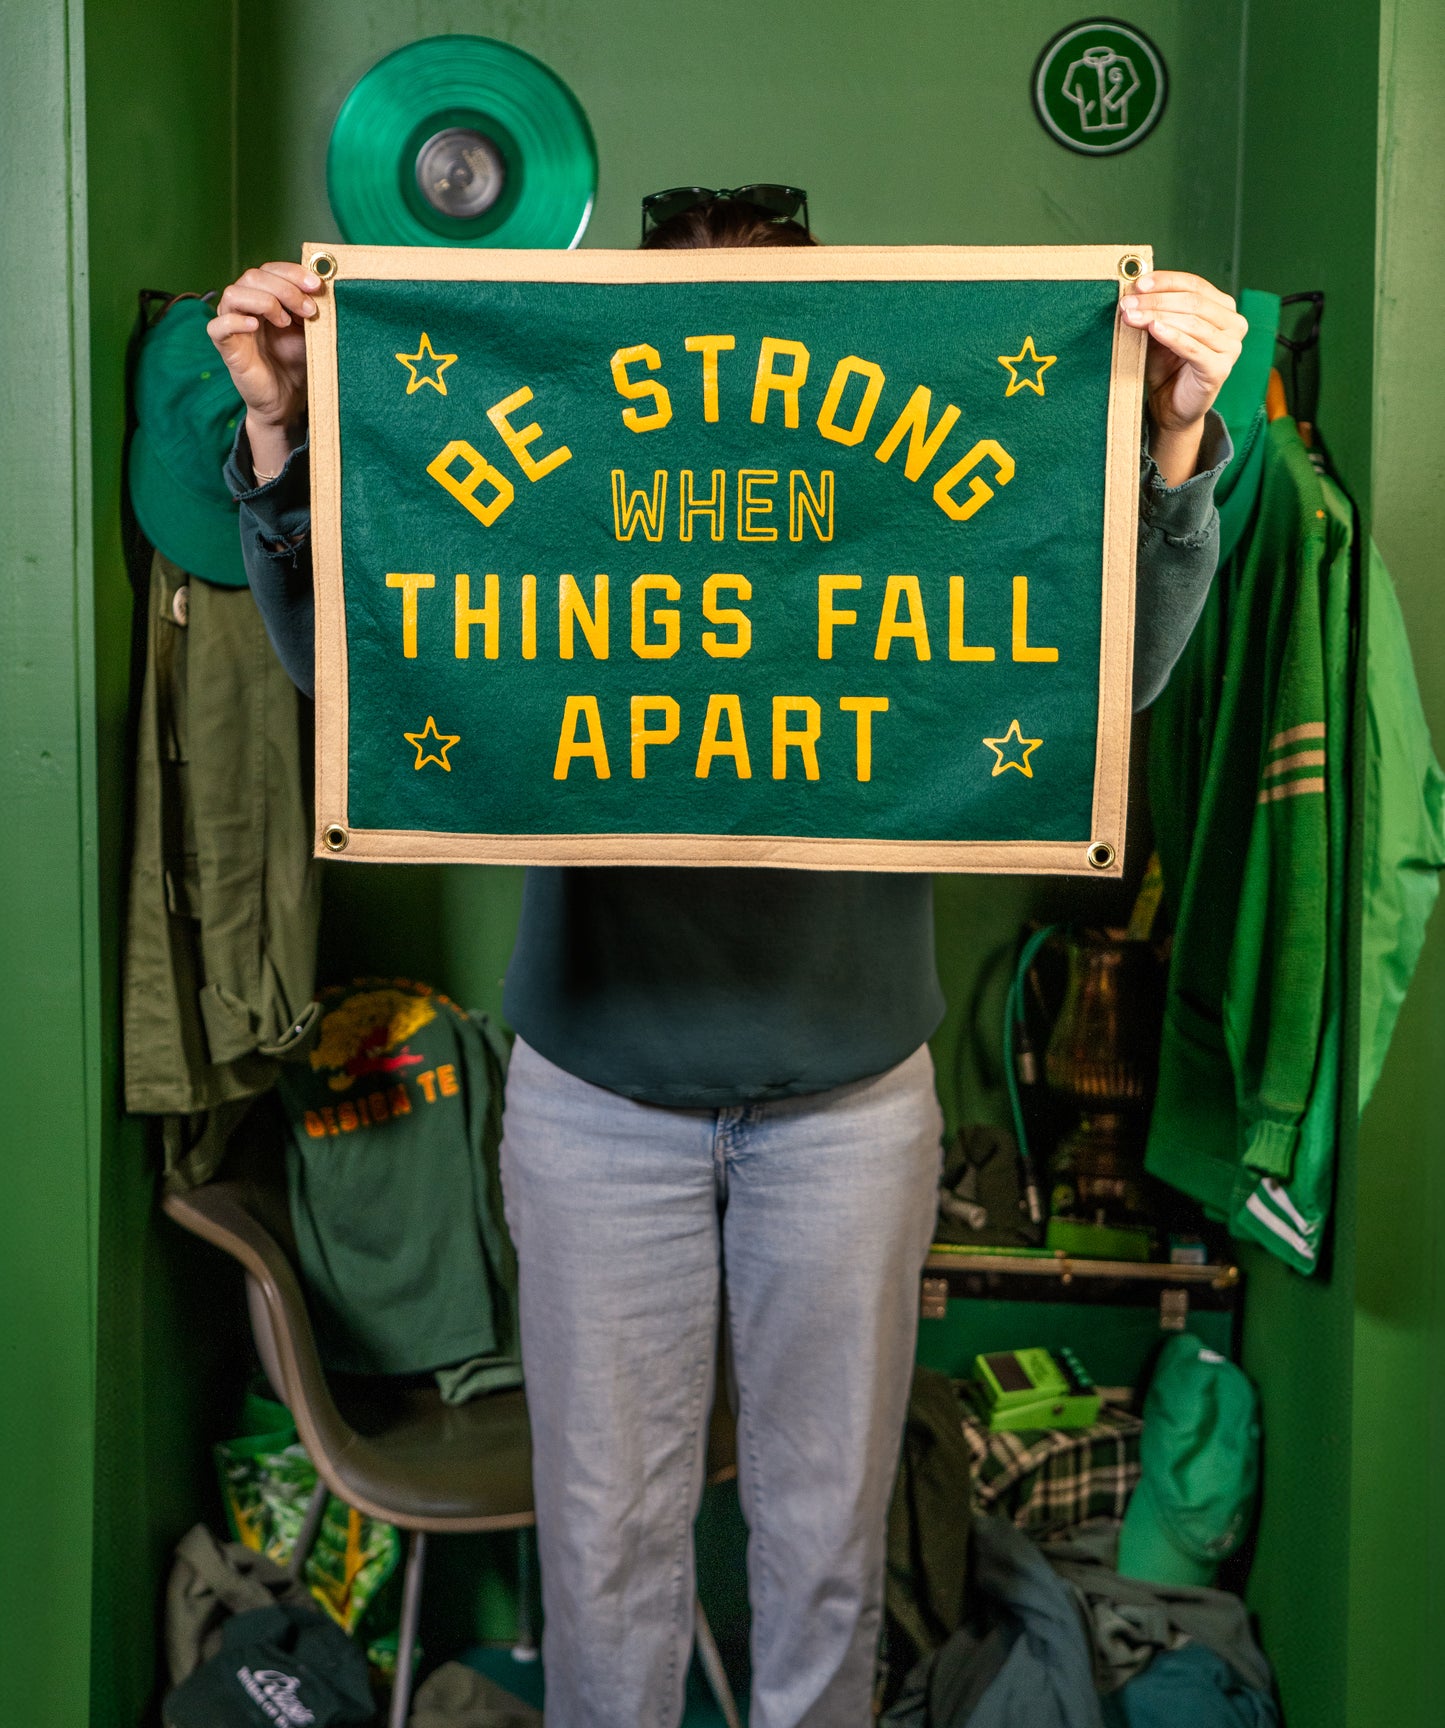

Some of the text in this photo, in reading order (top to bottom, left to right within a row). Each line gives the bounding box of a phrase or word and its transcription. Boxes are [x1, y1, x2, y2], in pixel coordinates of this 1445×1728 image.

[425, 335, 1016, 528] BE STRONG
[611, 469, 835, 542] WHEN
[385, 573, 1059, 663] THINGS FALL
[553, 694, 890, 782] APART
